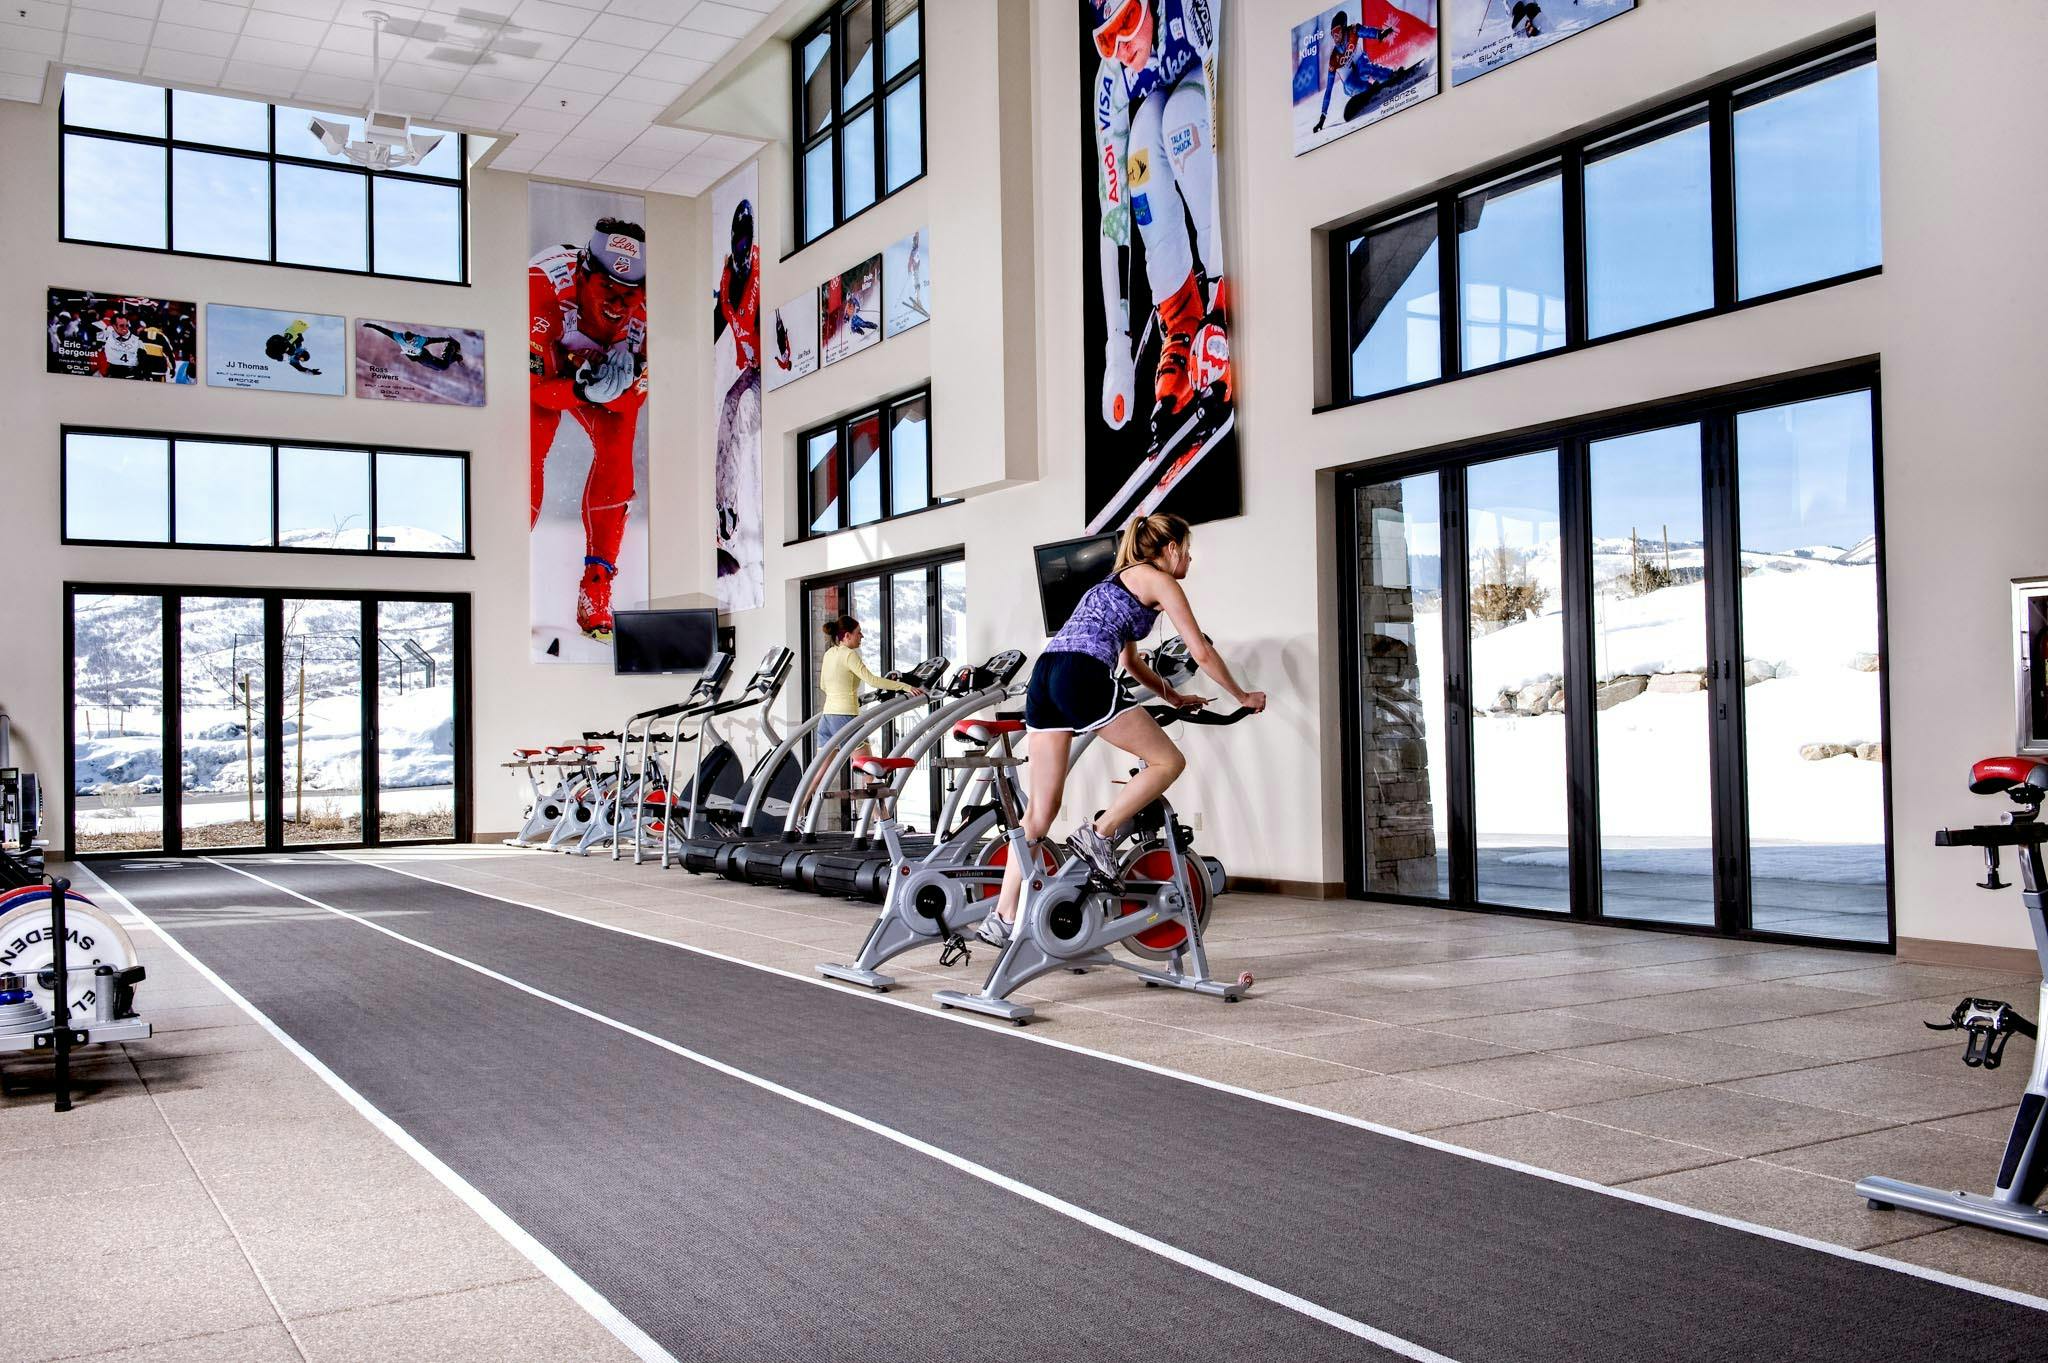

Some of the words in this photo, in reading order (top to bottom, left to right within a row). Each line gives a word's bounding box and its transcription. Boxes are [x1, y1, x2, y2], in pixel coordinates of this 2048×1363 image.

[1303, 31, 1324, 46] Chris
[1299, 45, 1317, 60] Klug
[1479, 42, 1497, 52] LAKE
[1479, 44, 1513, 62] SILVER
[1099, 77, 1112, 131] VISA
[1383, 87, 1417, 106] BRONZE
[1171, 134, 1182, 144] TALK
[1184, 129, 1191, 138] TO
[1173, 138, 1191, 156] CHUCK
[609, 236, 638, 256] Lilly
[59, 347, 98, 357] Bergoust
[120, 353, 129, 363] 4
[238, 361, 269, 371] Thomas
[369, 365, 389, 373] Ross
[371, 372, 399, 381] Powers
